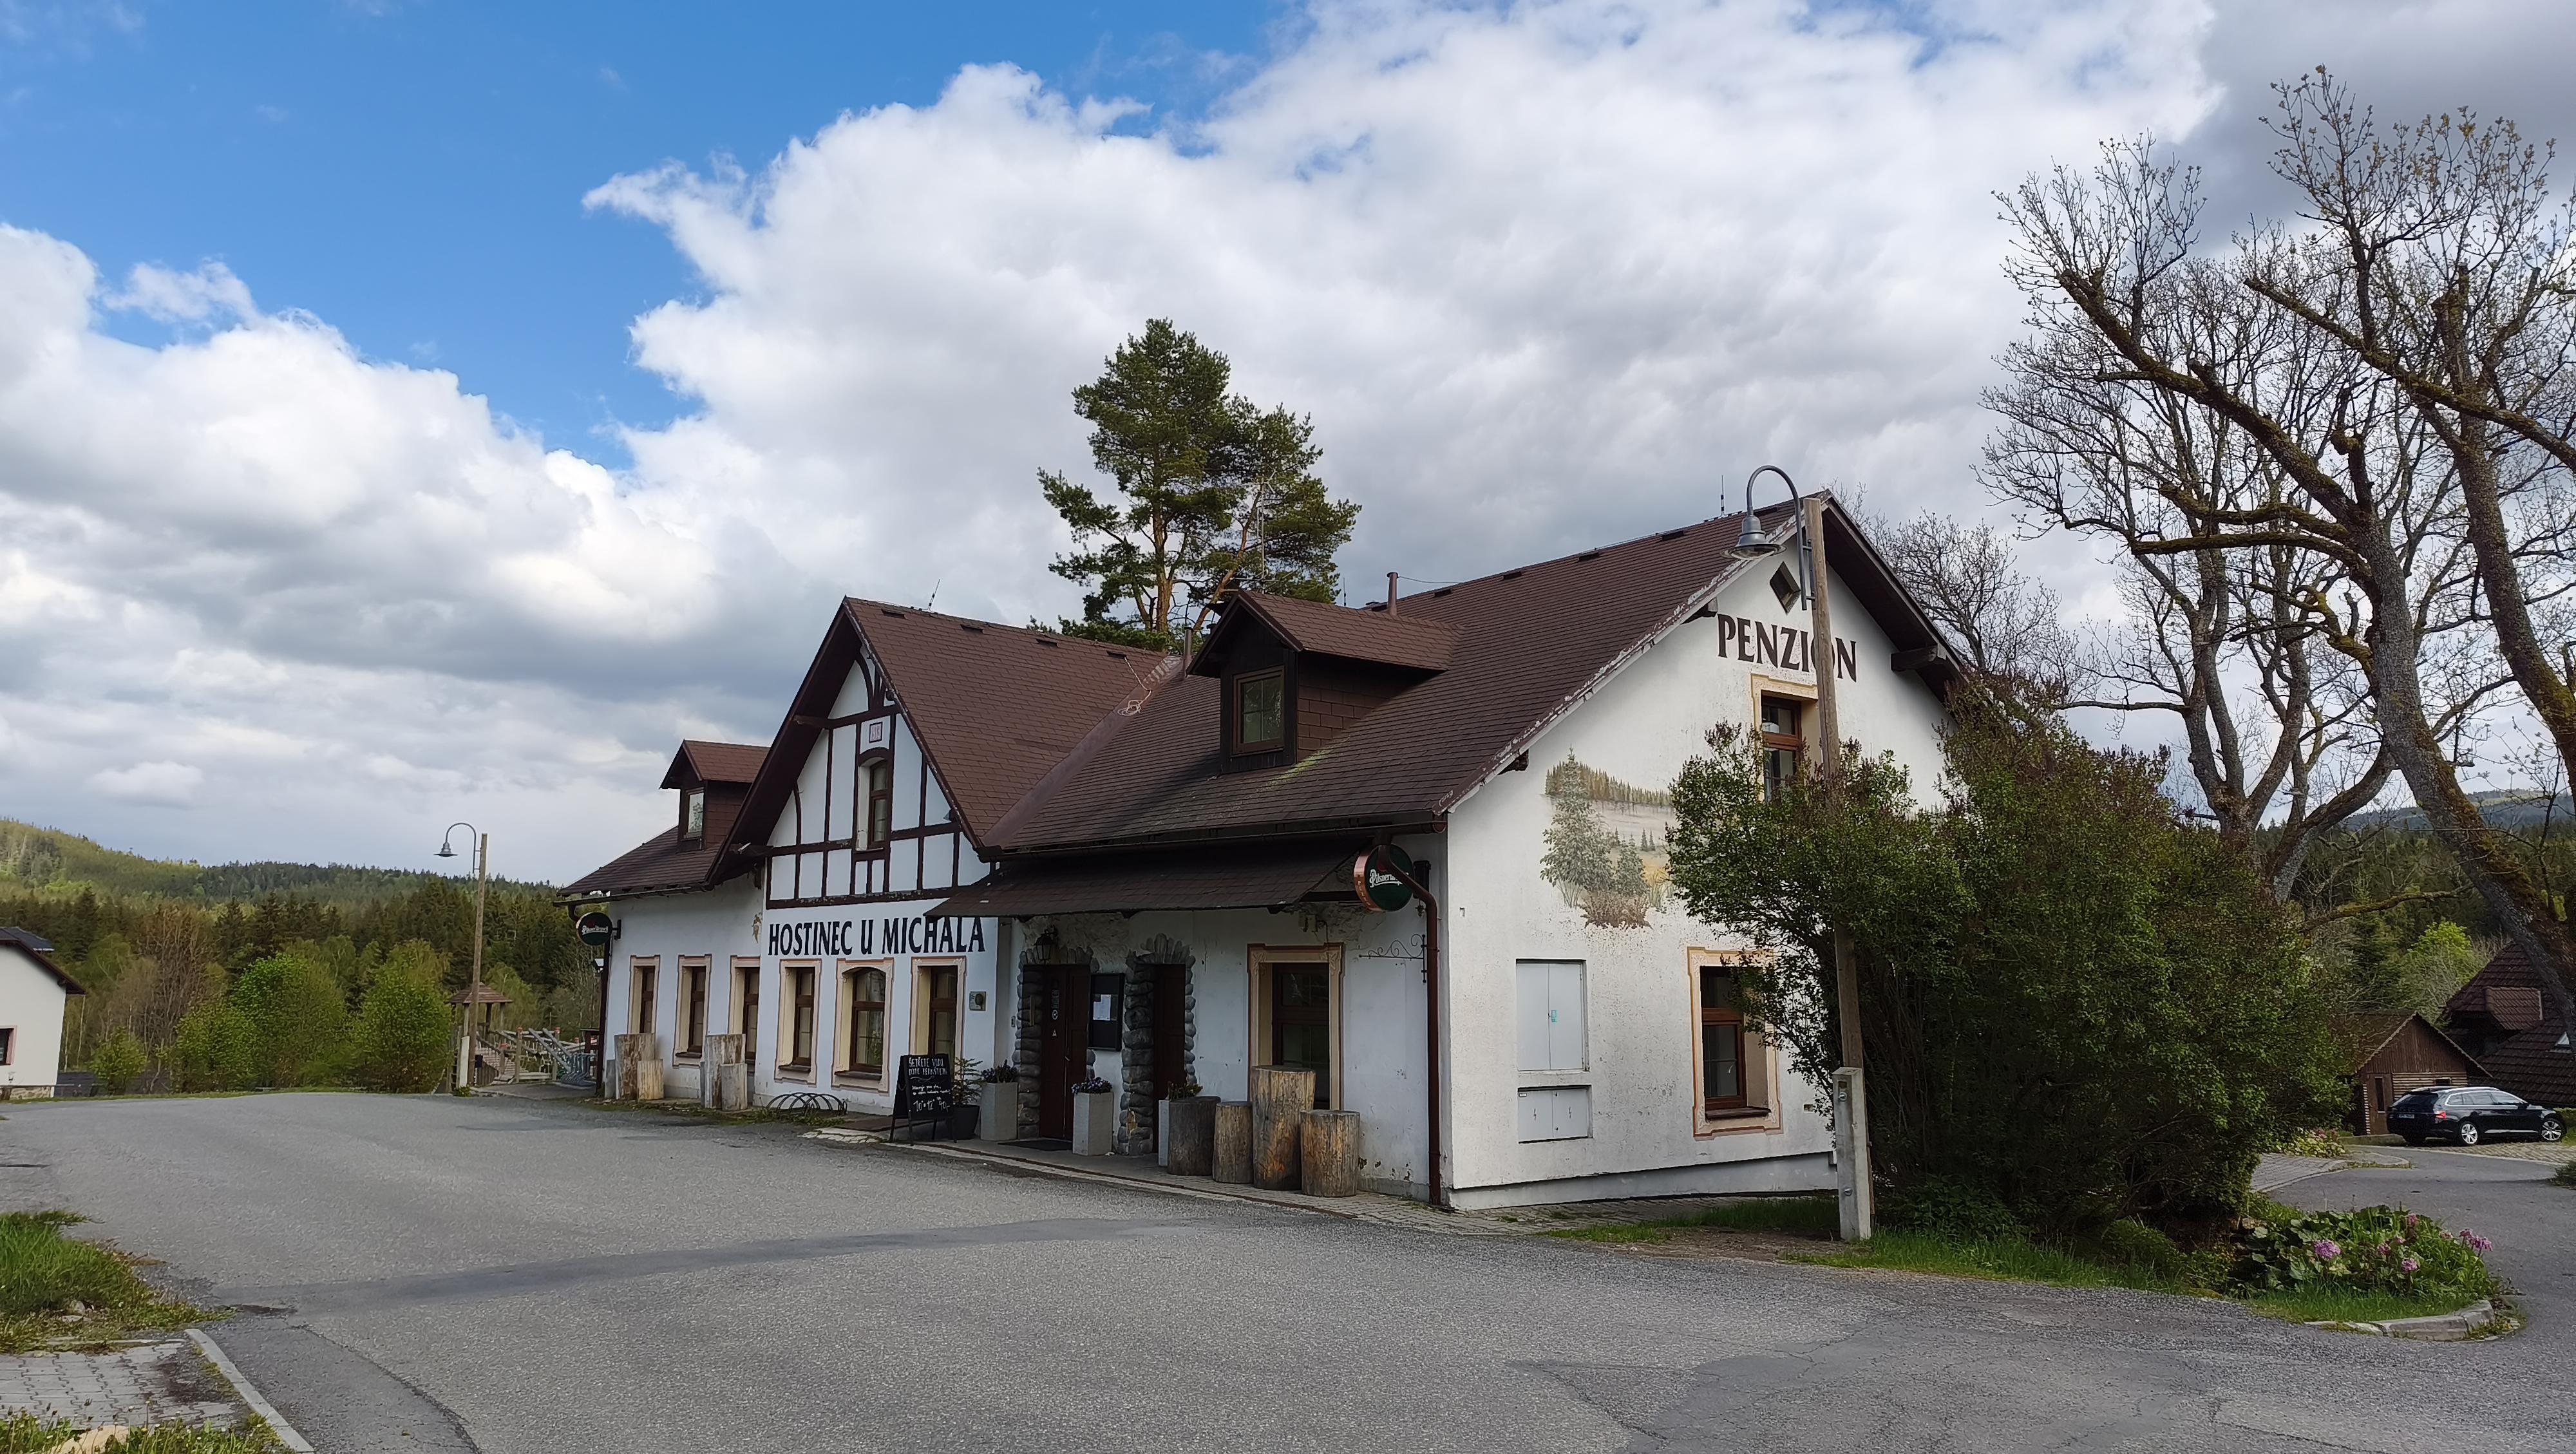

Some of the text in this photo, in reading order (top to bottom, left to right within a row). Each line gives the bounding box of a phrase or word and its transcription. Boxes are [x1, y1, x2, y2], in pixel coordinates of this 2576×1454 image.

[1718, 614, 1857, 683] PENZIN
[768, 917, 986, 956] HOSTINEC U MICHALA
